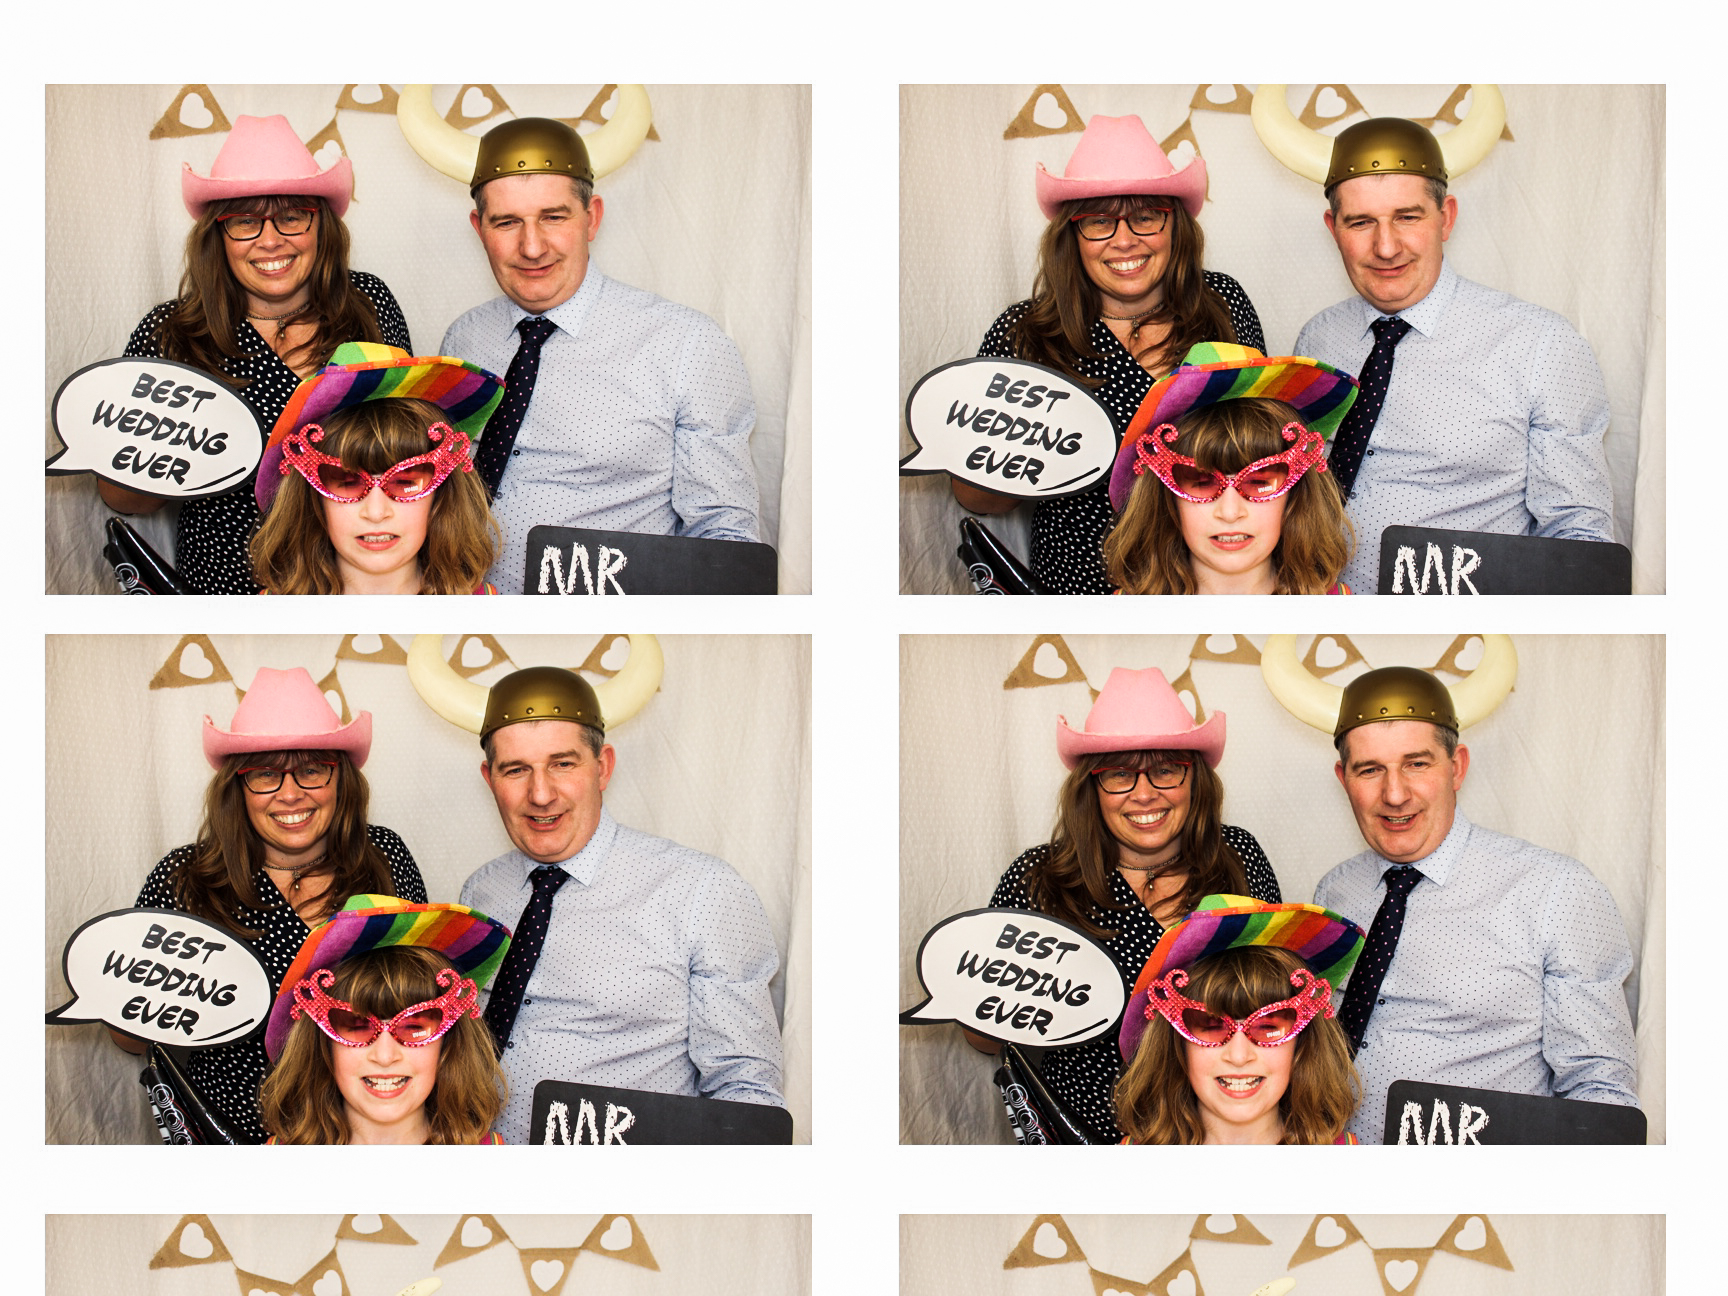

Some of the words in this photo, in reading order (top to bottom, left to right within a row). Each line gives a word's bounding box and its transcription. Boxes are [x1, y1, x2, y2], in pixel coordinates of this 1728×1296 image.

[131, 372, 217, 413] BEST
[985, 372, 1071, 413] BEST
[92, 399, 229, 456] WEDDING
[946, 399, 1083, 456] WEDDING
[111, 445, 191, 485] EVER
[965, 445, 1045, 485] EVER
[537, 541, 628, 595] MR
[1391, 541, 1482, 595] MR
[141, 923, 227, 965] BEST
[995, 923, 1081, 965] BEST
[102, 949, 238, 1007] WEDDING
[956, 949, 1092, 1007] WEDDING
[121, 995, 200, 1036] EVER
[975, 995, 1054, 1036] EVER
[543, 1097, 636, 1145] MR
[1397, 1097, 1490, 1145] MR
